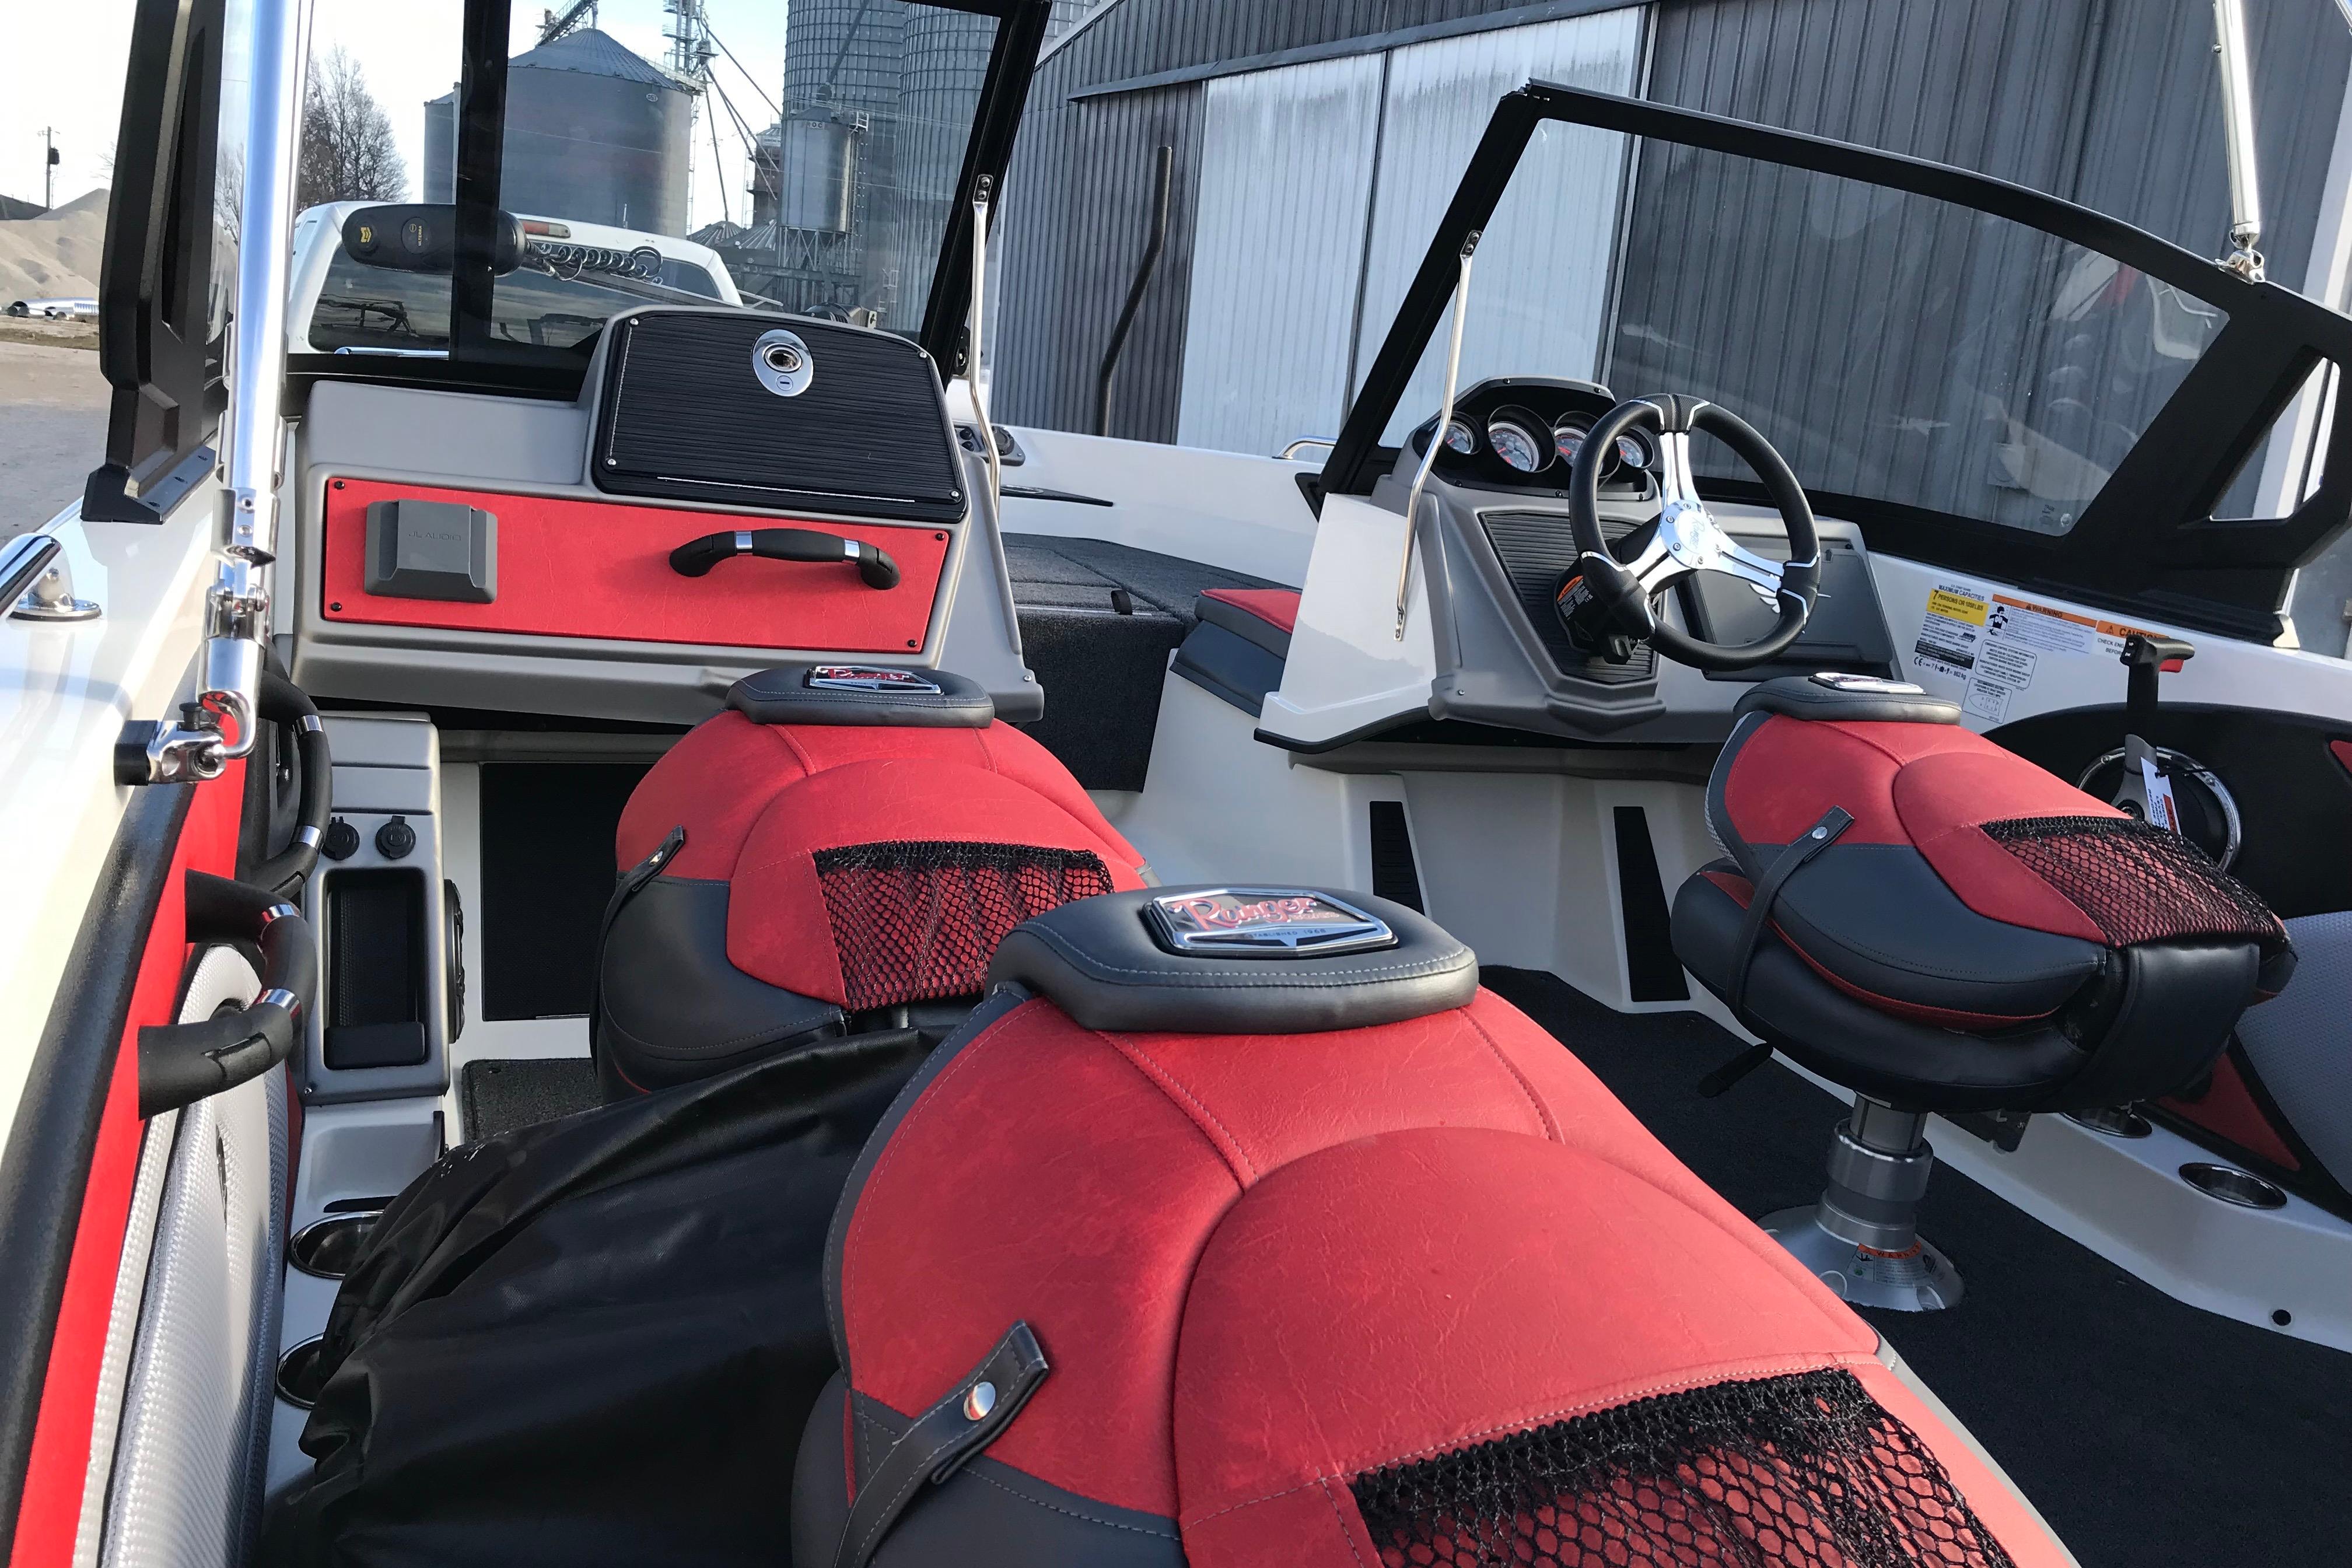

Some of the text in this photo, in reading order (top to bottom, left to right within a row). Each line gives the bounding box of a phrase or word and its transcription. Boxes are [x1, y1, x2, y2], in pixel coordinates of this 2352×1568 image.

[1933, 590, 1939, 600] 7
[1937, 594, 1958, 604] PERSONS
[1938, 584, 1985, 601] MAXIMUM CAPACITIES
[2032, 604, 2063, 618] WARNING
[2097, 638, 2113, 646] CHECK
[1169, 897, 1317, 931] Ranger
